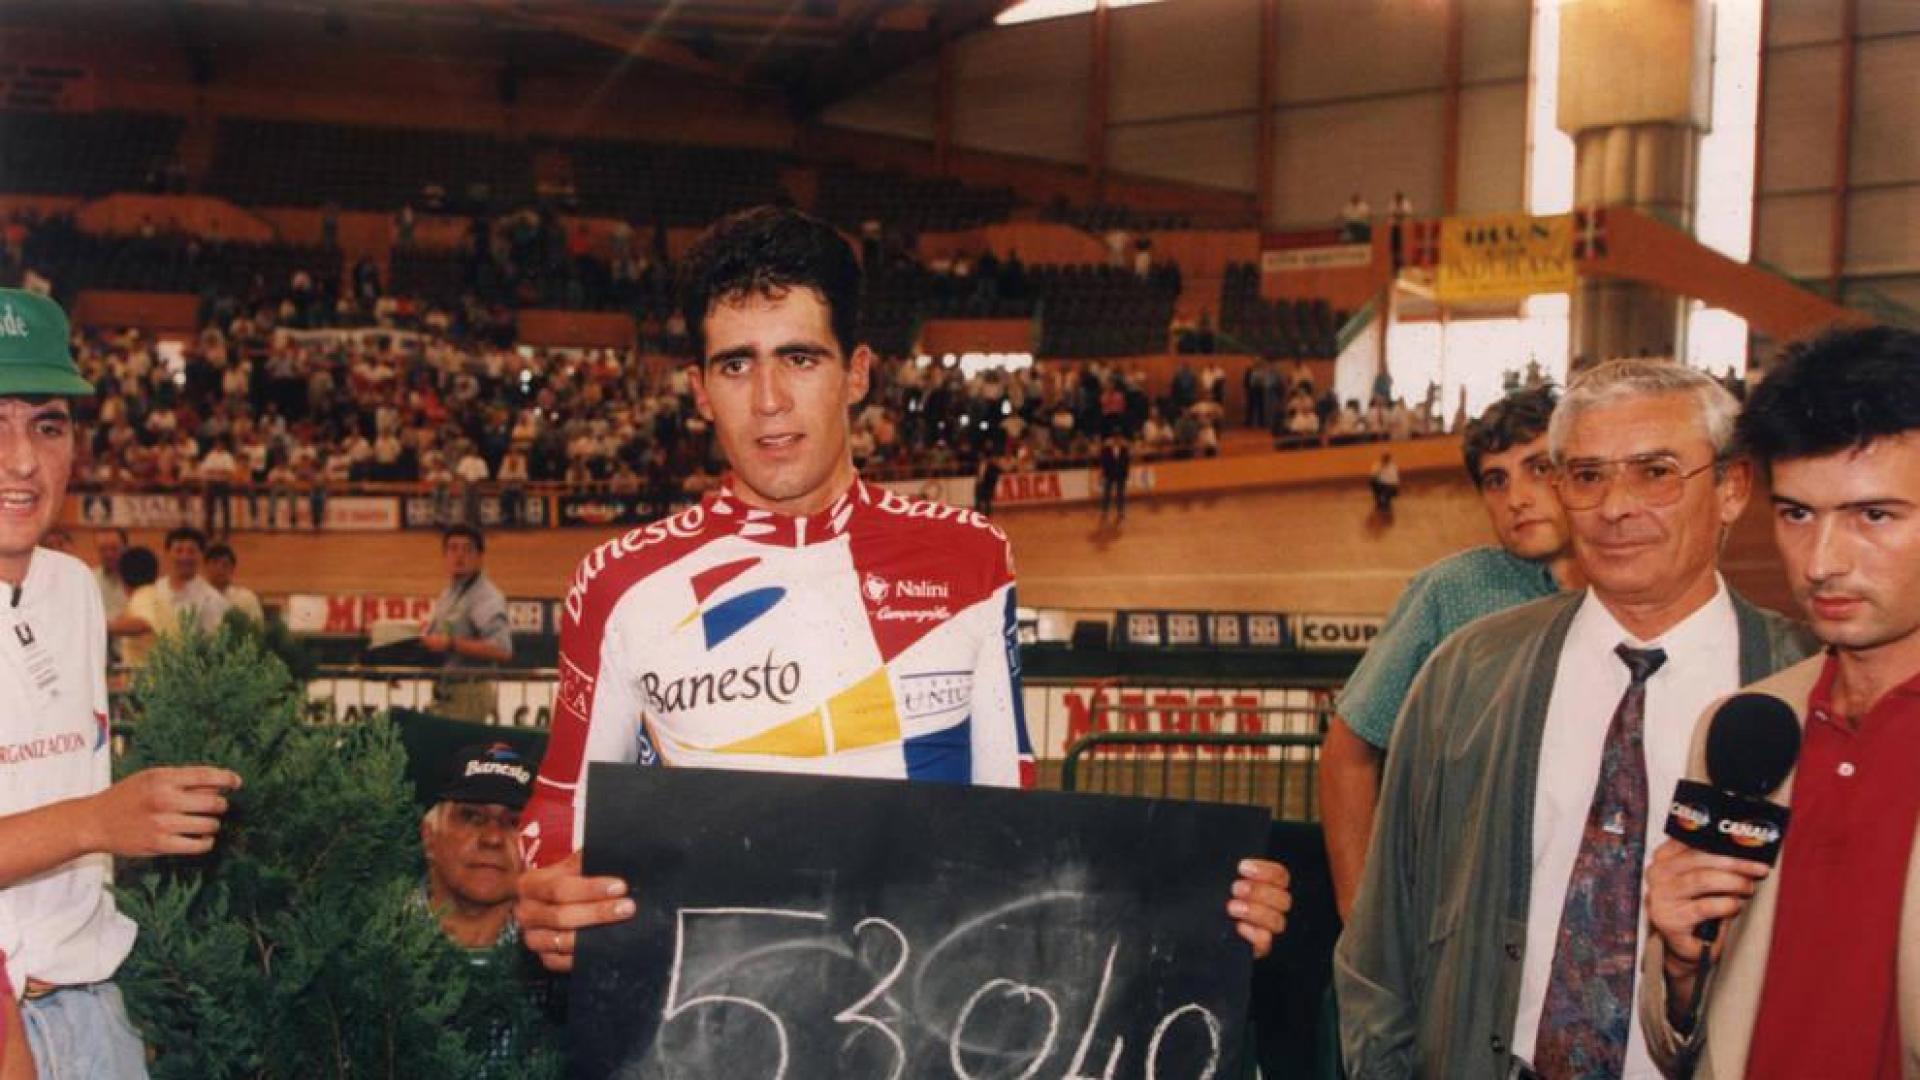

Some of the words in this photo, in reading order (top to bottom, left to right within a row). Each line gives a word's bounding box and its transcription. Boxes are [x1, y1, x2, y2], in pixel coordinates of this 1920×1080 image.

[996, 472, 1062, 501] ARCA
[896, 580, 948, 597] Nalini
[638, 649, 801, 714] Banesto
[465, 759, 531, 785] Banesto
[1718, 818, 1780, 843] CANAL+
